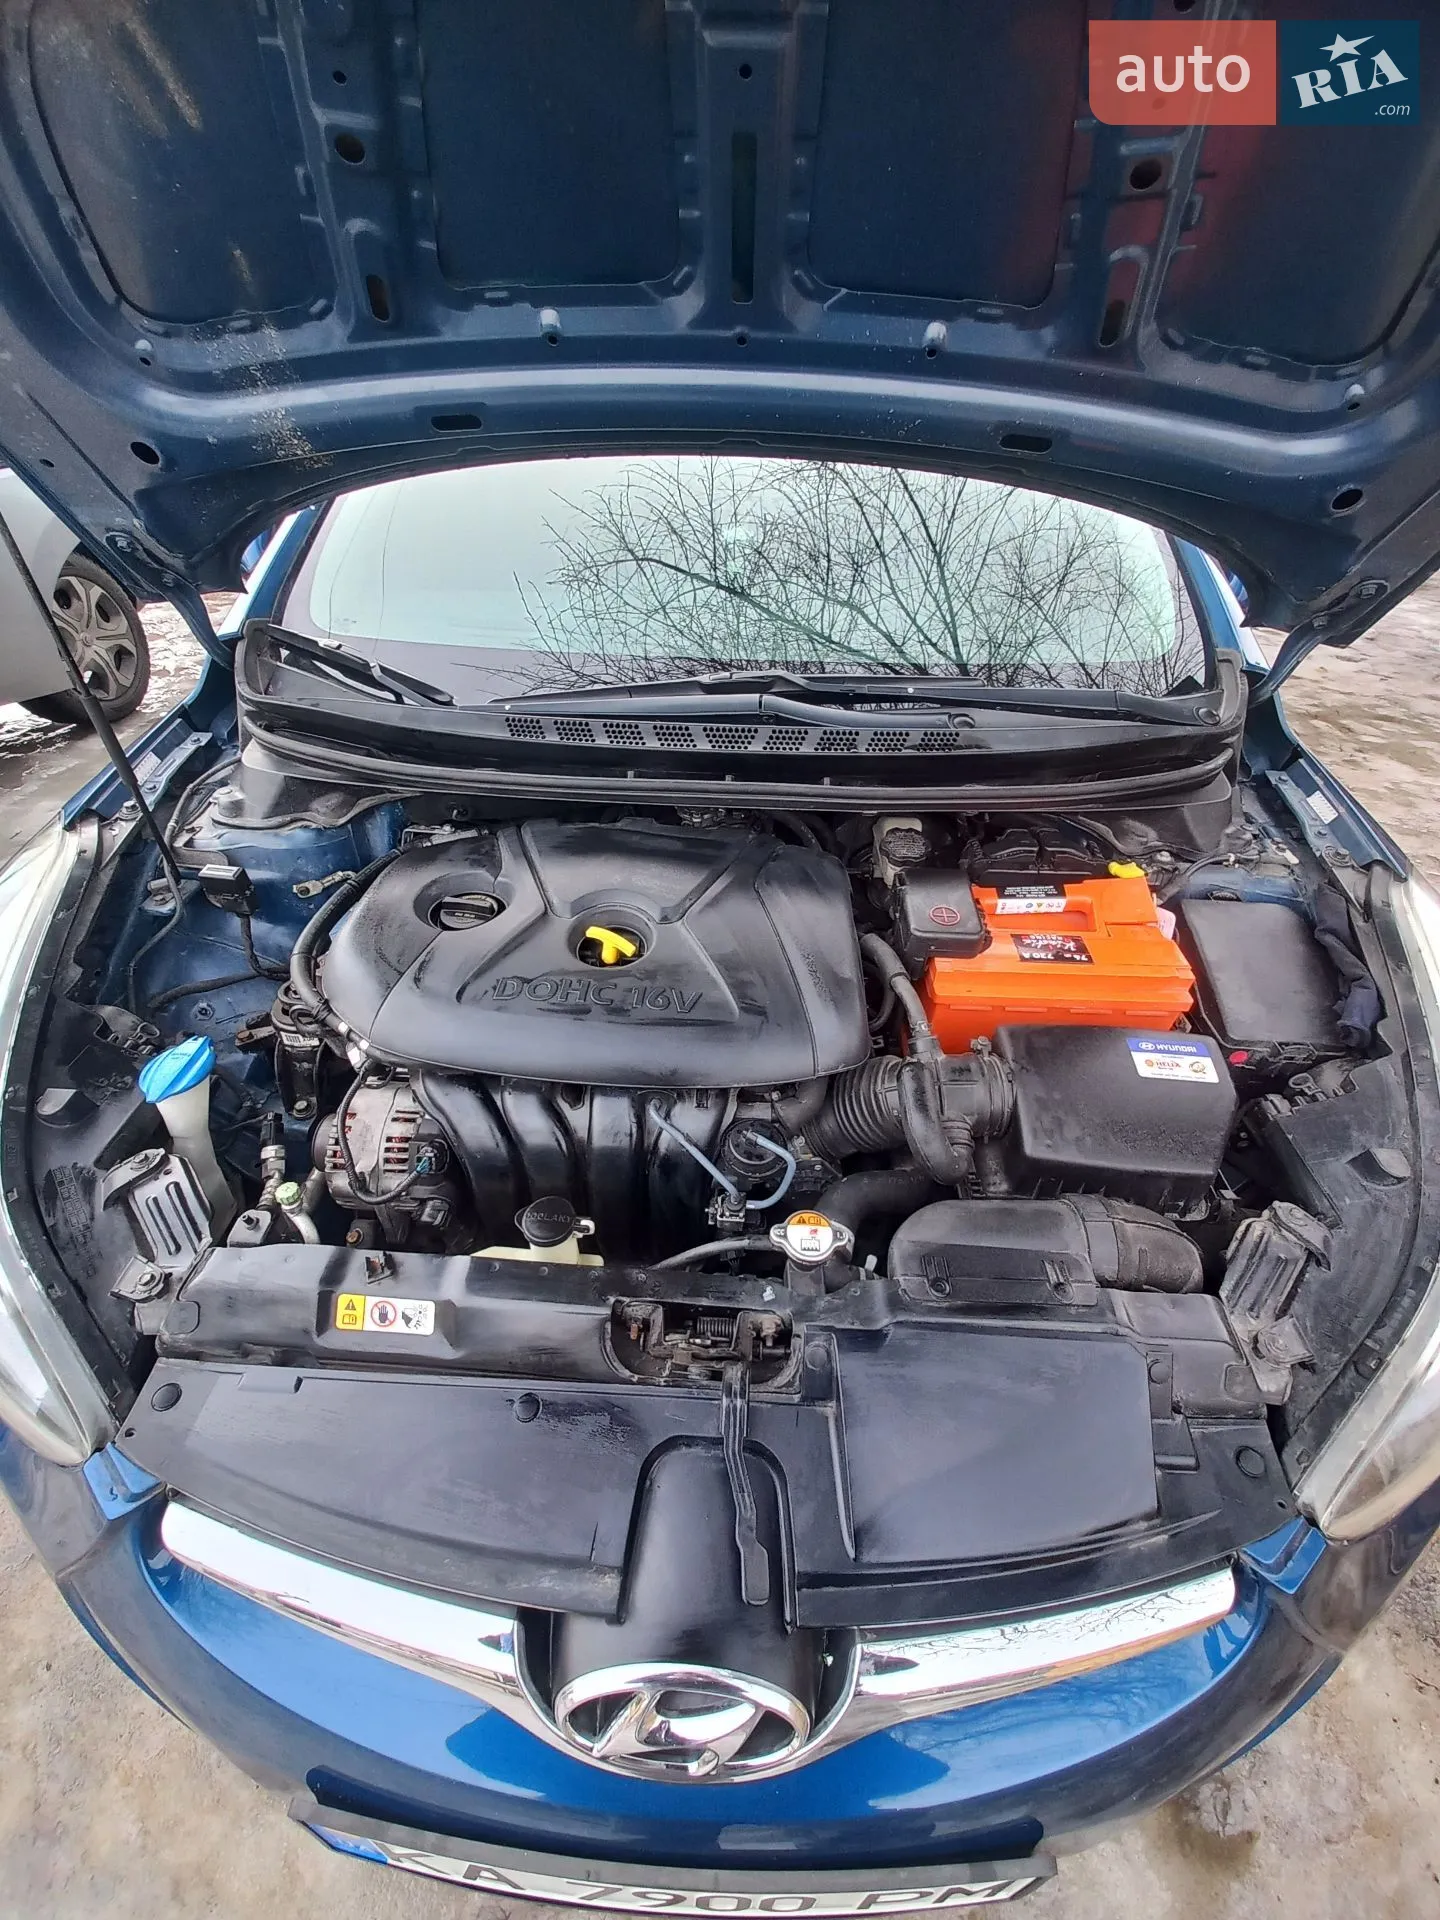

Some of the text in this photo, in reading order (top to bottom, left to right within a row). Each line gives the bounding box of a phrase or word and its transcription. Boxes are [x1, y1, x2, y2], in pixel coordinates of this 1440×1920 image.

[492, 977, 703, 1013] DOHC 16V
[1155, 1043, 1197, 1053] HYUNDAI
[566, 1880, 817, 1912] 7900
[857, 1880, 1016, 1910] PM
